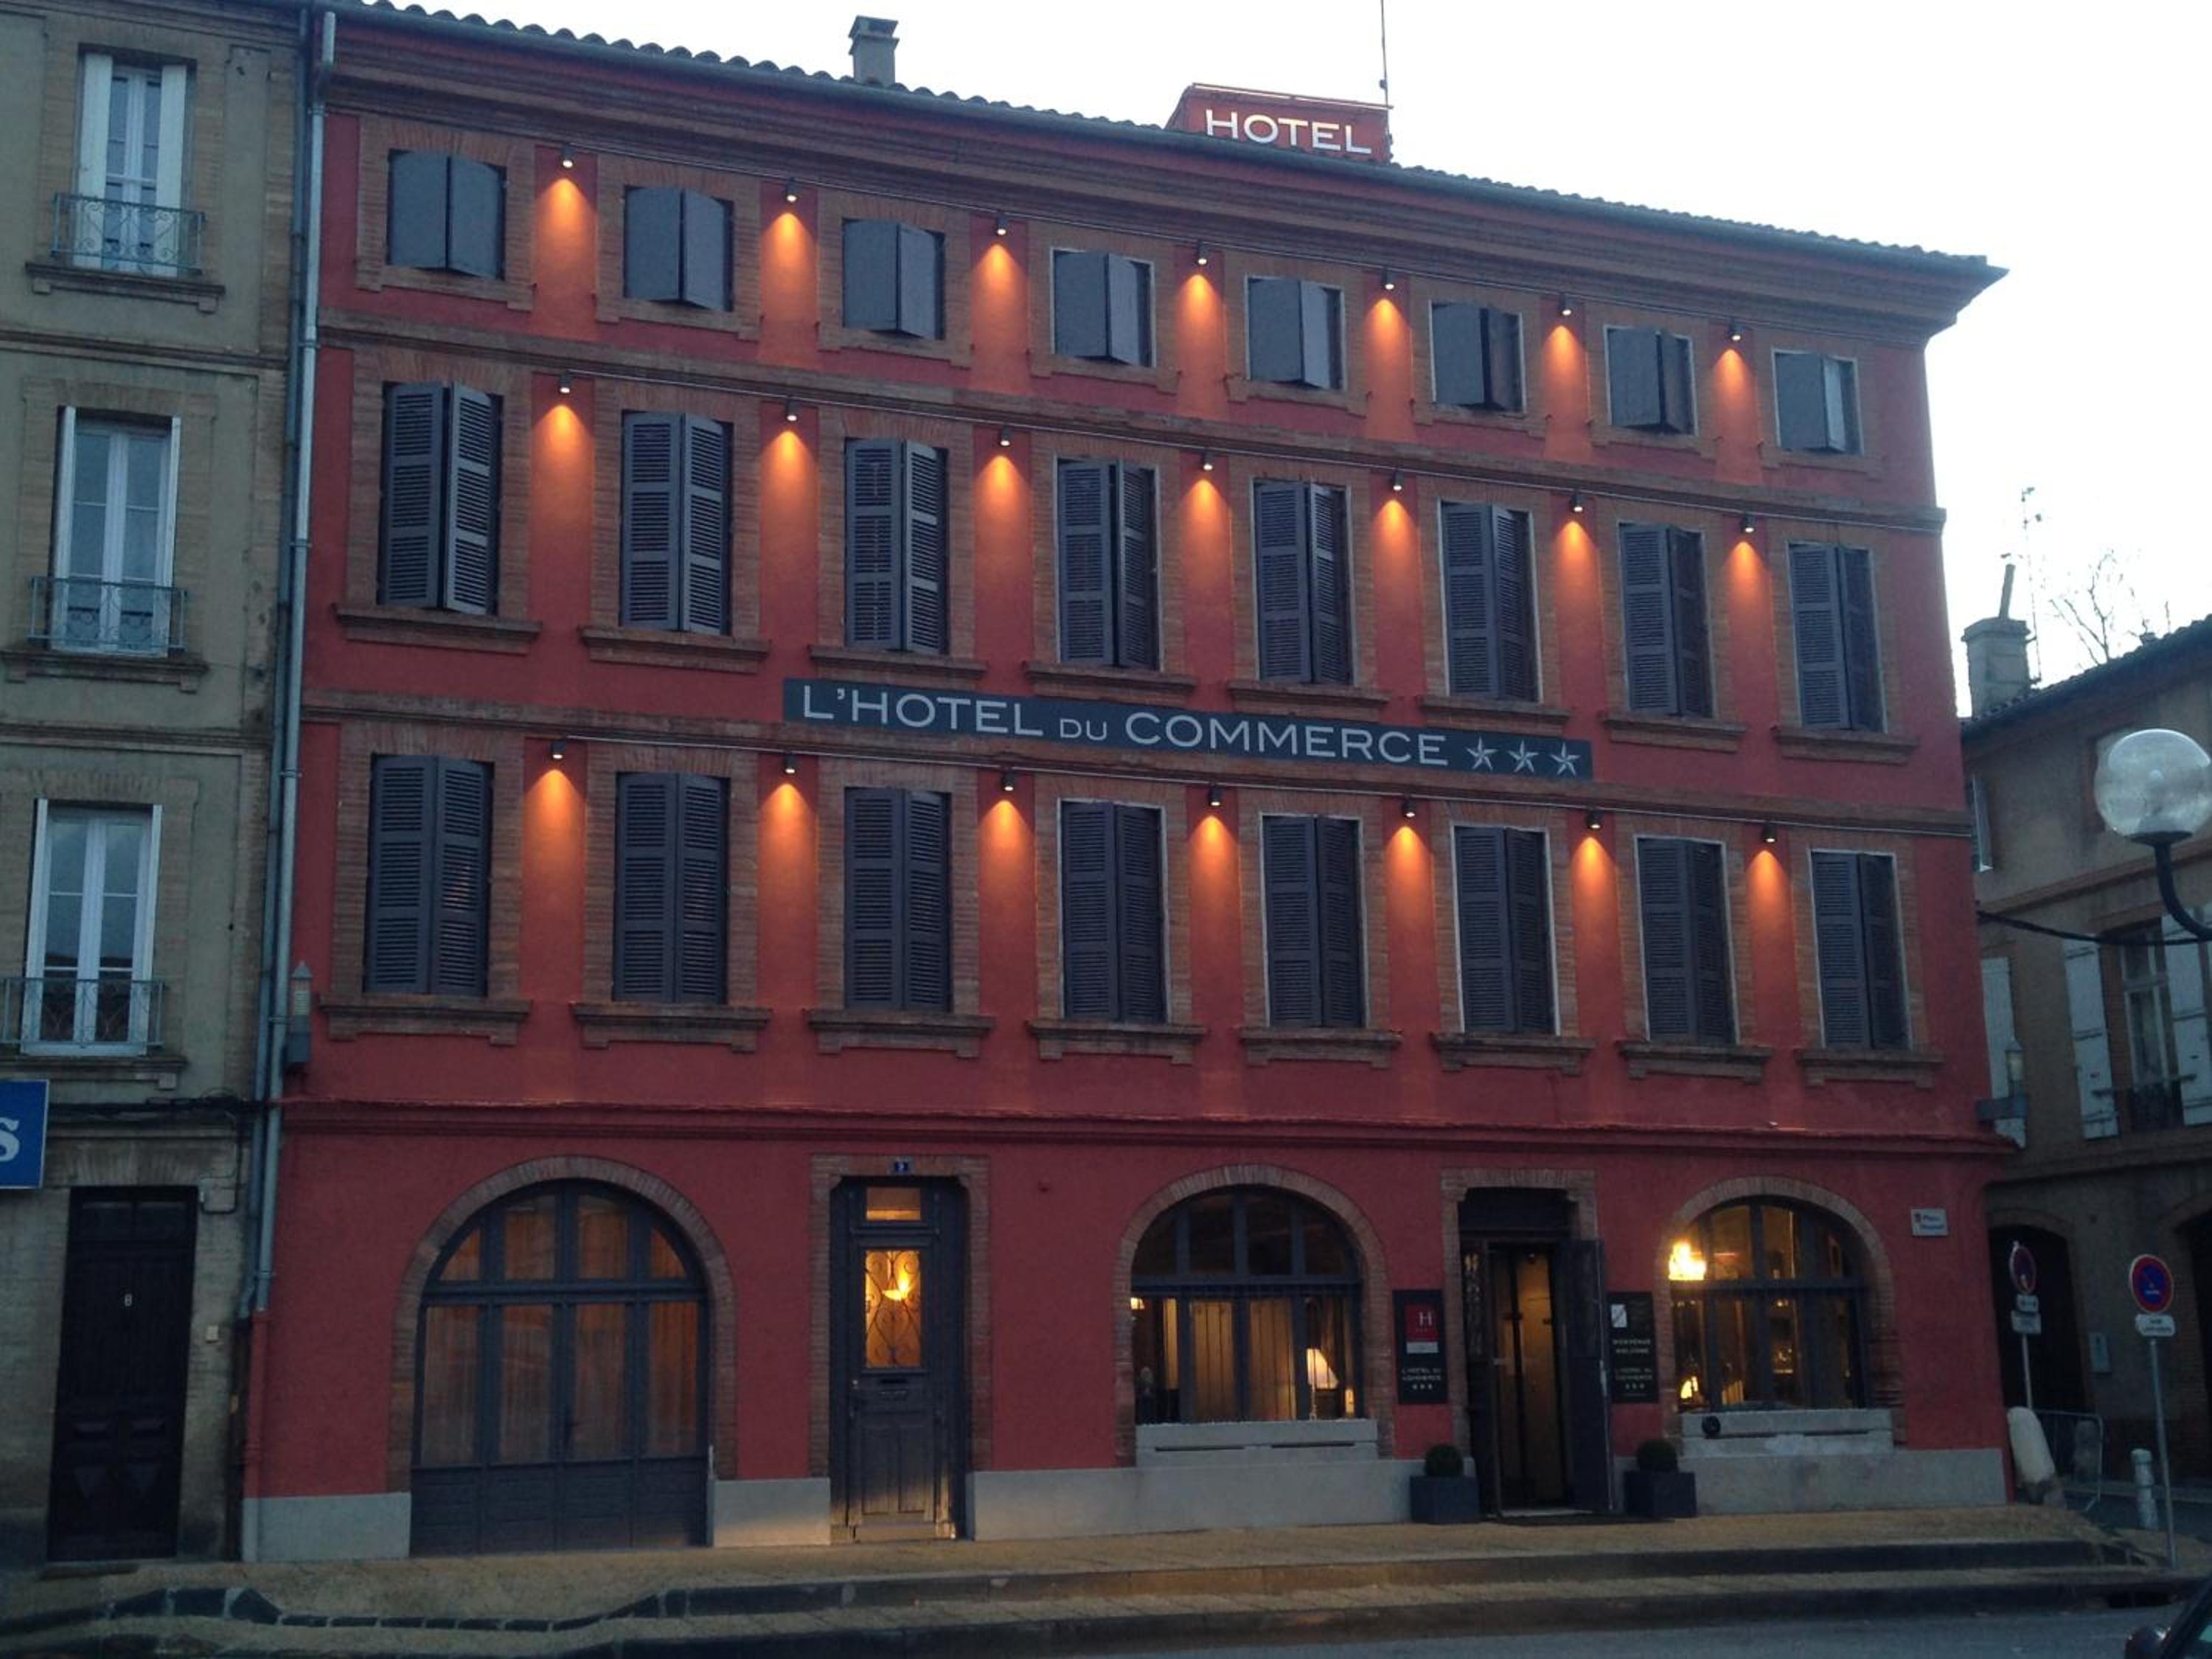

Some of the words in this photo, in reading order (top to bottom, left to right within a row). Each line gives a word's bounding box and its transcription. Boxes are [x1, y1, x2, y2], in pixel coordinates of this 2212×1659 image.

[1205, 108, 1372, 155] HOTEL
[803, 684, 1044, 737] L'HOTEL
[1059, 718, 1107, 741] DU
[1124, 711, 1449, 766] COMMERCE
